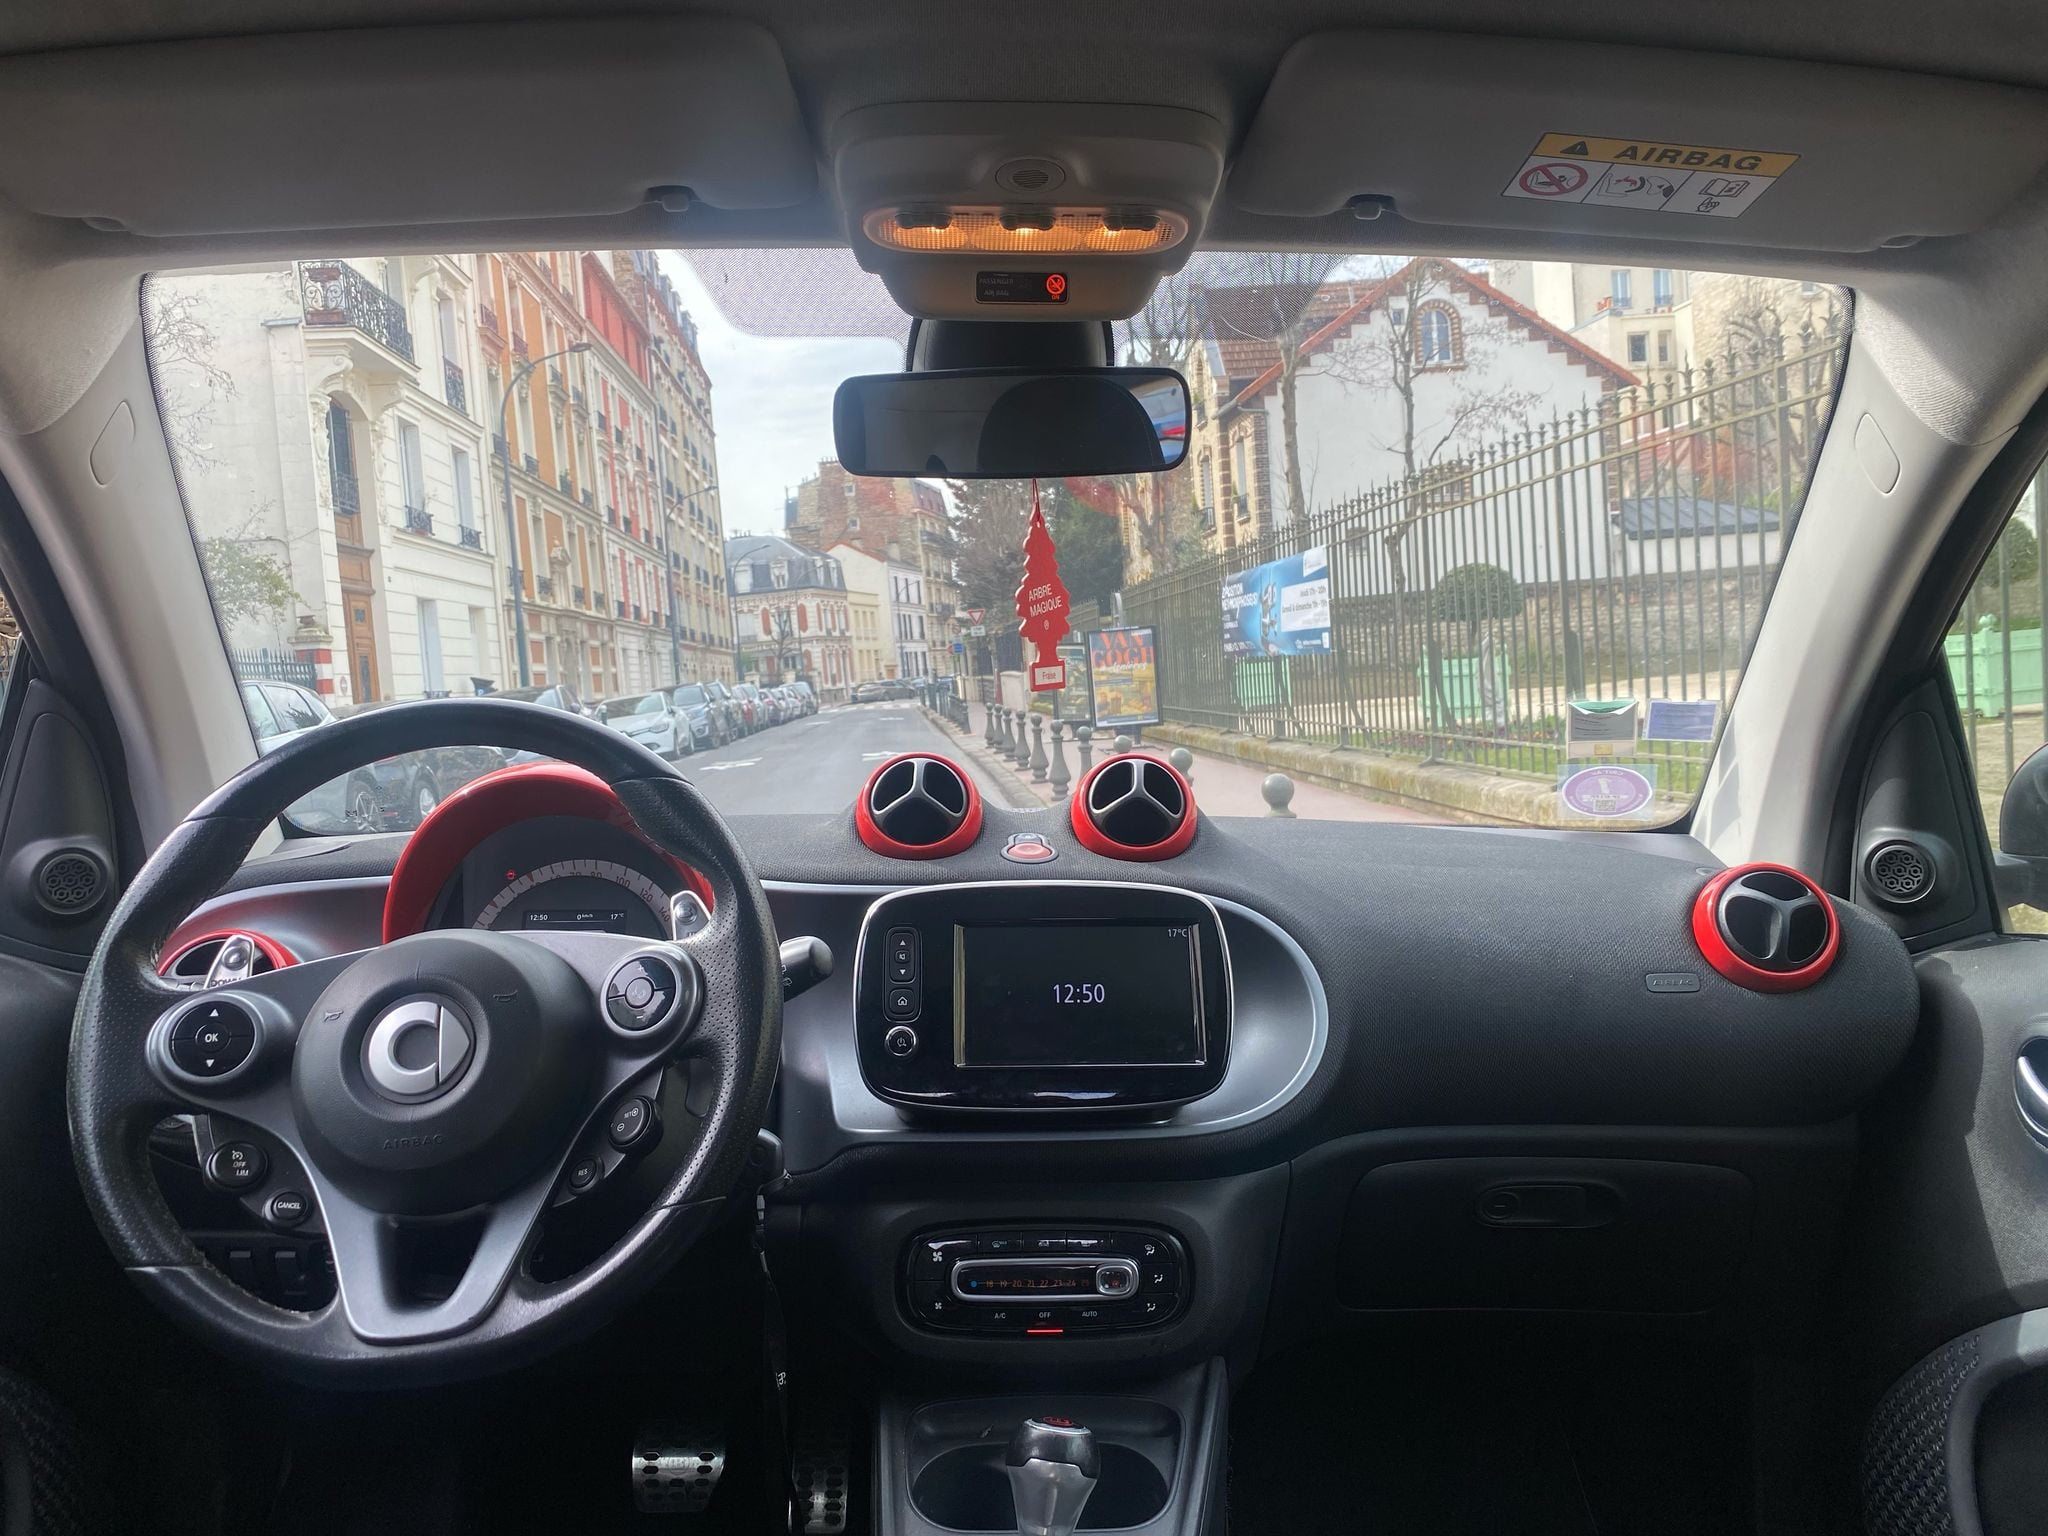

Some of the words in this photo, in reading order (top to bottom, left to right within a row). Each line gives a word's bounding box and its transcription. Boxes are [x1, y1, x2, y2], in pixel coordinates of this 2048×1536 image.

[1614, 145, 1762, 171] AIRBAG
[1028, 583, 1053, 602] ARBRE
[1029, 595, 1063, 617] MAGIQUE
[1098, 630, 1145, 649] VAN
[1092, 645, 1155, 669] GOGH
[1042, 671, 1057, 680] Fraise
[615, 875, 631, 889] 100
[639, 886, 654, 901] 120
[529, 913, 548, 921] 12:50
[658, 905, 671, 922] 140
[1167, 928, 1188, 938] 17°C
[1052, 983, 1106, 1004] 12:50
[204, 1033, 219, 1043] OK
[384, 1134, 445, 1150] AIRBAG
[578, 1168, 588, 1176] RES
[277, 1202, 301, 1210] CANCEL
[1081, 1310, 1098, 1318] AUTO
